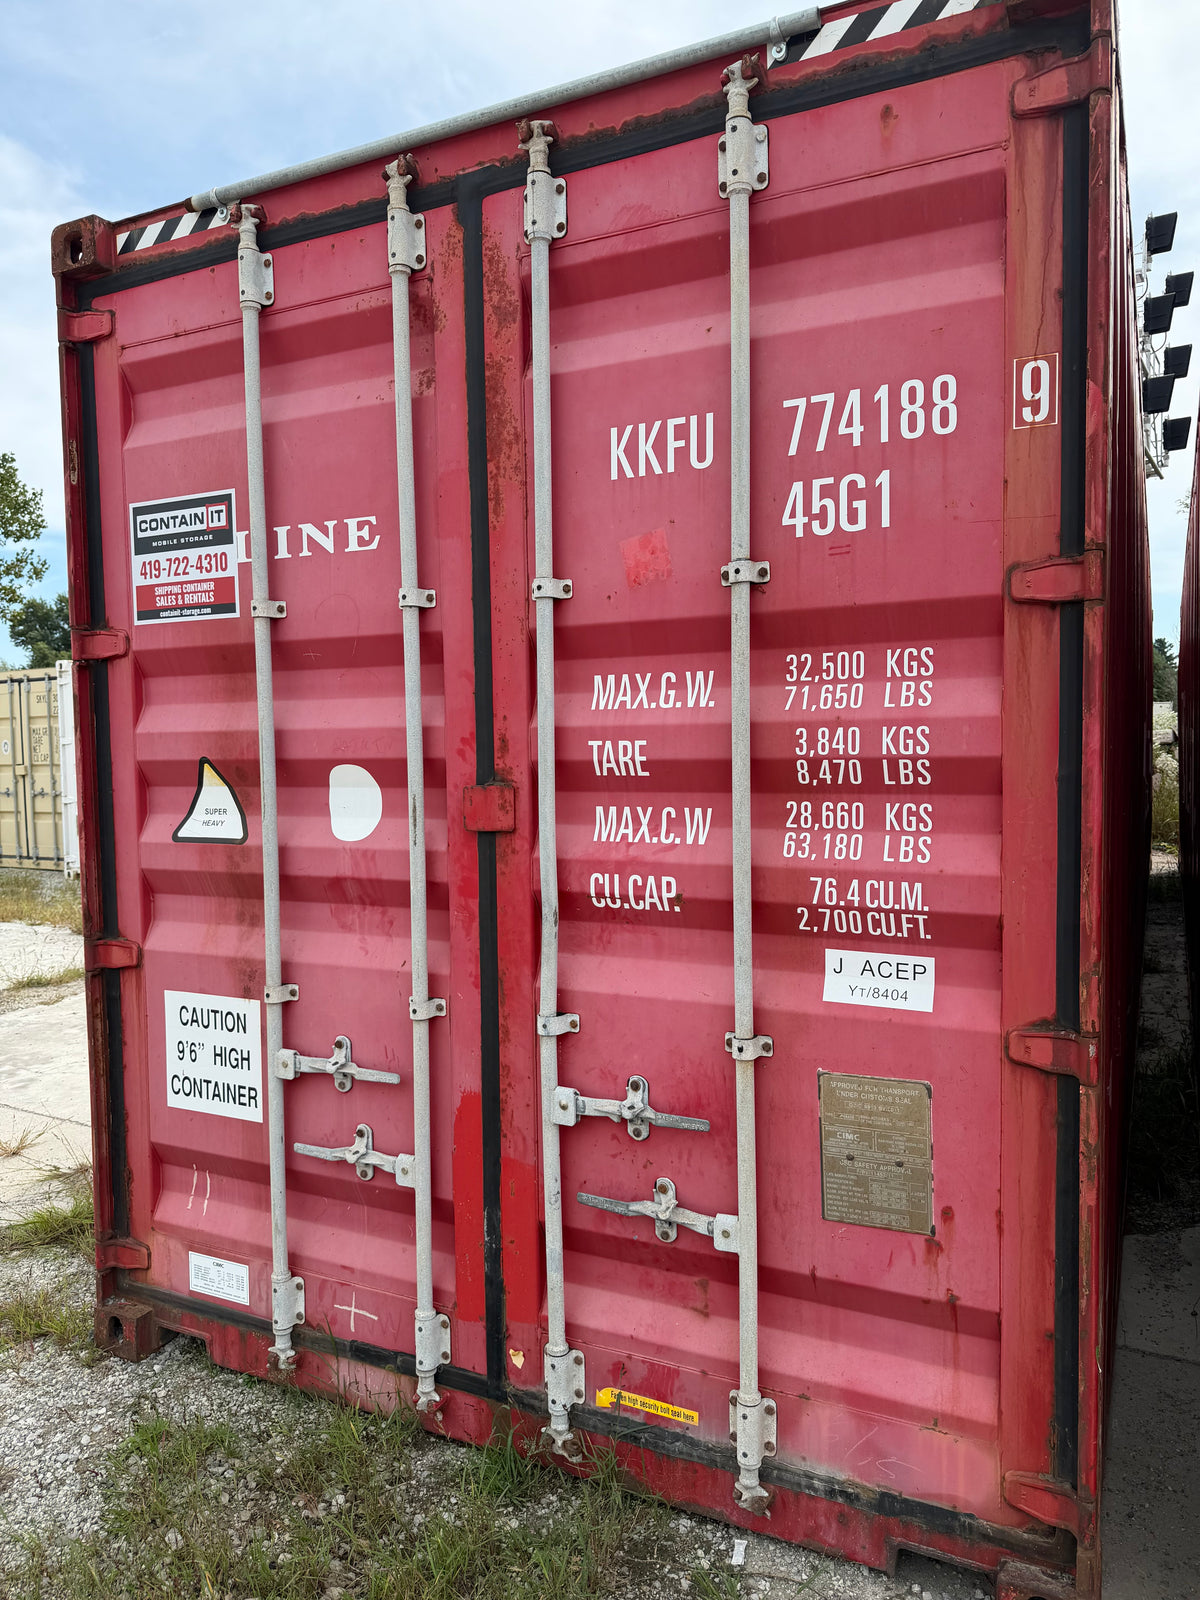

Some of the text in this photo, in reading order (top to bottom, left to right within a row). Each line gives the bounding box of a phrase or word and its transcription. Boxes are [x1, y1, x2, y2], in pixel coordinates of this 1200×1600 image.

[611, 361, 1050, 480] KKFU 774188 9
[782, 470, 889, 537] 45G1
[152, 535, 213, 547] MOBILE STORAGE
[236, 515, 381, 563] LINE
[140, 552, 228, 580] 419-722-4310
[155, 582, 214, 595] SHIPPING CONTAINER
[156, 592, 214, 607] SALES & RENTALS
[160, 607, 211, 617] containit-storage.com
[786, 647, 933, 685] 32,500 KGS
[591, 671, 714, 710] MAX.G.W.
[783, 681, 933, 712] 71,650 LBS
[795, 725, 931, 757] 3,840 KGS
[588, 740, 649, 776] TARE
[797, 759, 932, 786] 8,470 LBS
[202, 819, 225, 827] HEAVY
[593, 806, 712, 845] MAX.C.W
[786, 801, 933, 832] 28,660 KGS
[782, 833, 932, 863] 63,180 LBS
[589, 873, 682, 912] CU.CAP.
[810, 877, 861, 907] 76.4
[797, 908, 932, 940] 2,700 CU.FT.
[833, 957, 927, 981] J ACEP
[179, 1005, 247, 1034] CAUTION
[213, 1045, 250, 1070] HIGH
[171, 1074, 258, 1109] CONTAINER
[837, 1132, 860, 1141] CIMC
[854, 1161, 877, 1169] SAFETY
[610, 1390, 694, 1422] Faen high security bolt seal here
